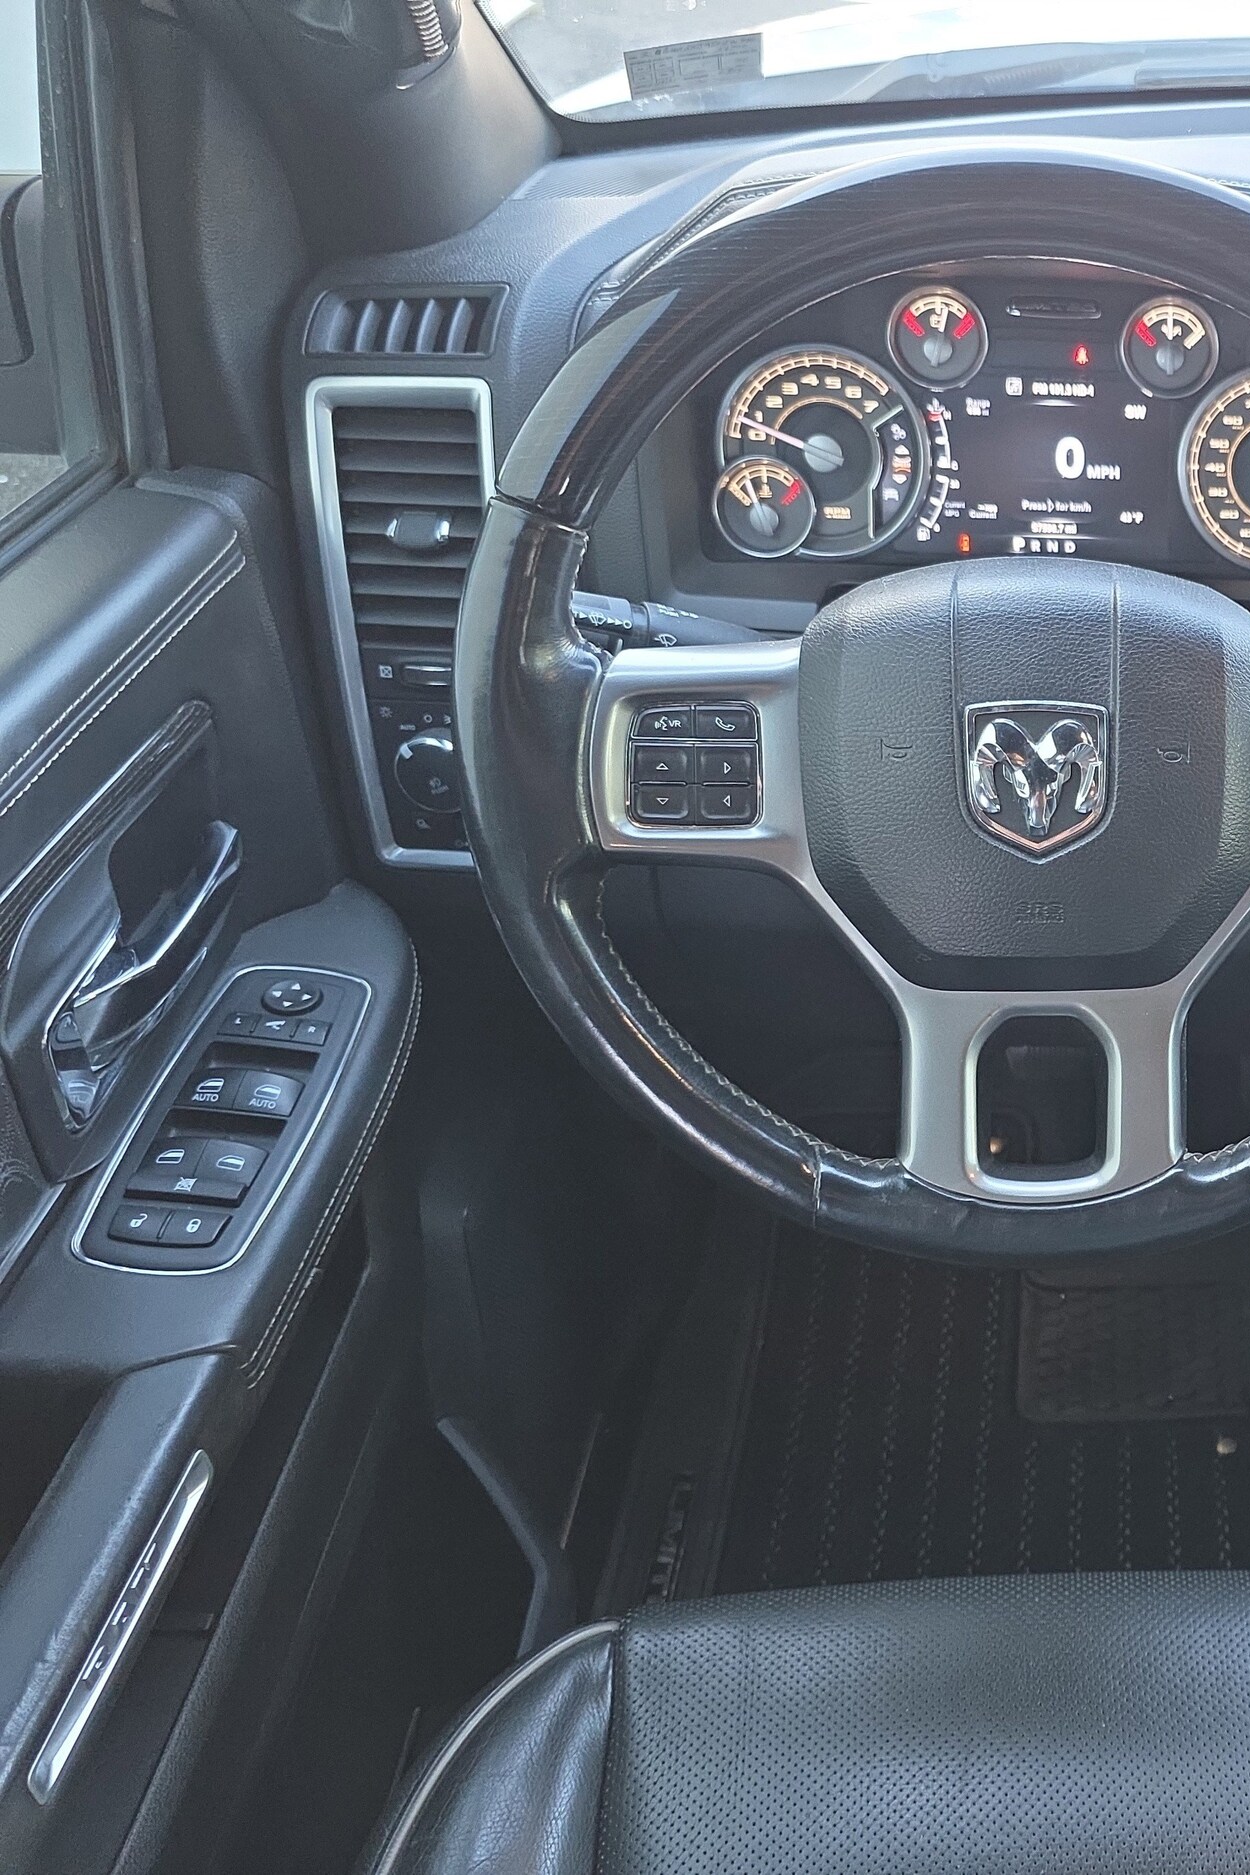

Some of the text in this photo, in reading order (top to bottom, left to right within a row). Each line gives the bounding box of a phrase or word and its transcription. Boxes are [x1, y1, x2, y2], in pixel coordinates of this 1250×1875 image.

[800, 373, 820, 387] 4
[824, 375, 842, 389] 5
[781, 382, 799, 395] 3
[844, 385, 862, 399] 6
[765, 395, 783, 409] 2
[862, 400, 879, 414] 7
[754, 410, 764, 423] 1
[1124, 404, 1147, 420] SW
[1055, 436, 1121, 480] 0 MPH
[1021, 498, 1092, 513] Press for km/h
[969, 508, 997, 519] Current
[1012, 536, 1076, 553] P R N D
[669, 719, 682, 728] VR
[192, 1093, 219, 1103] AUTO
[249, 1098, 276, 1109] AUTO
